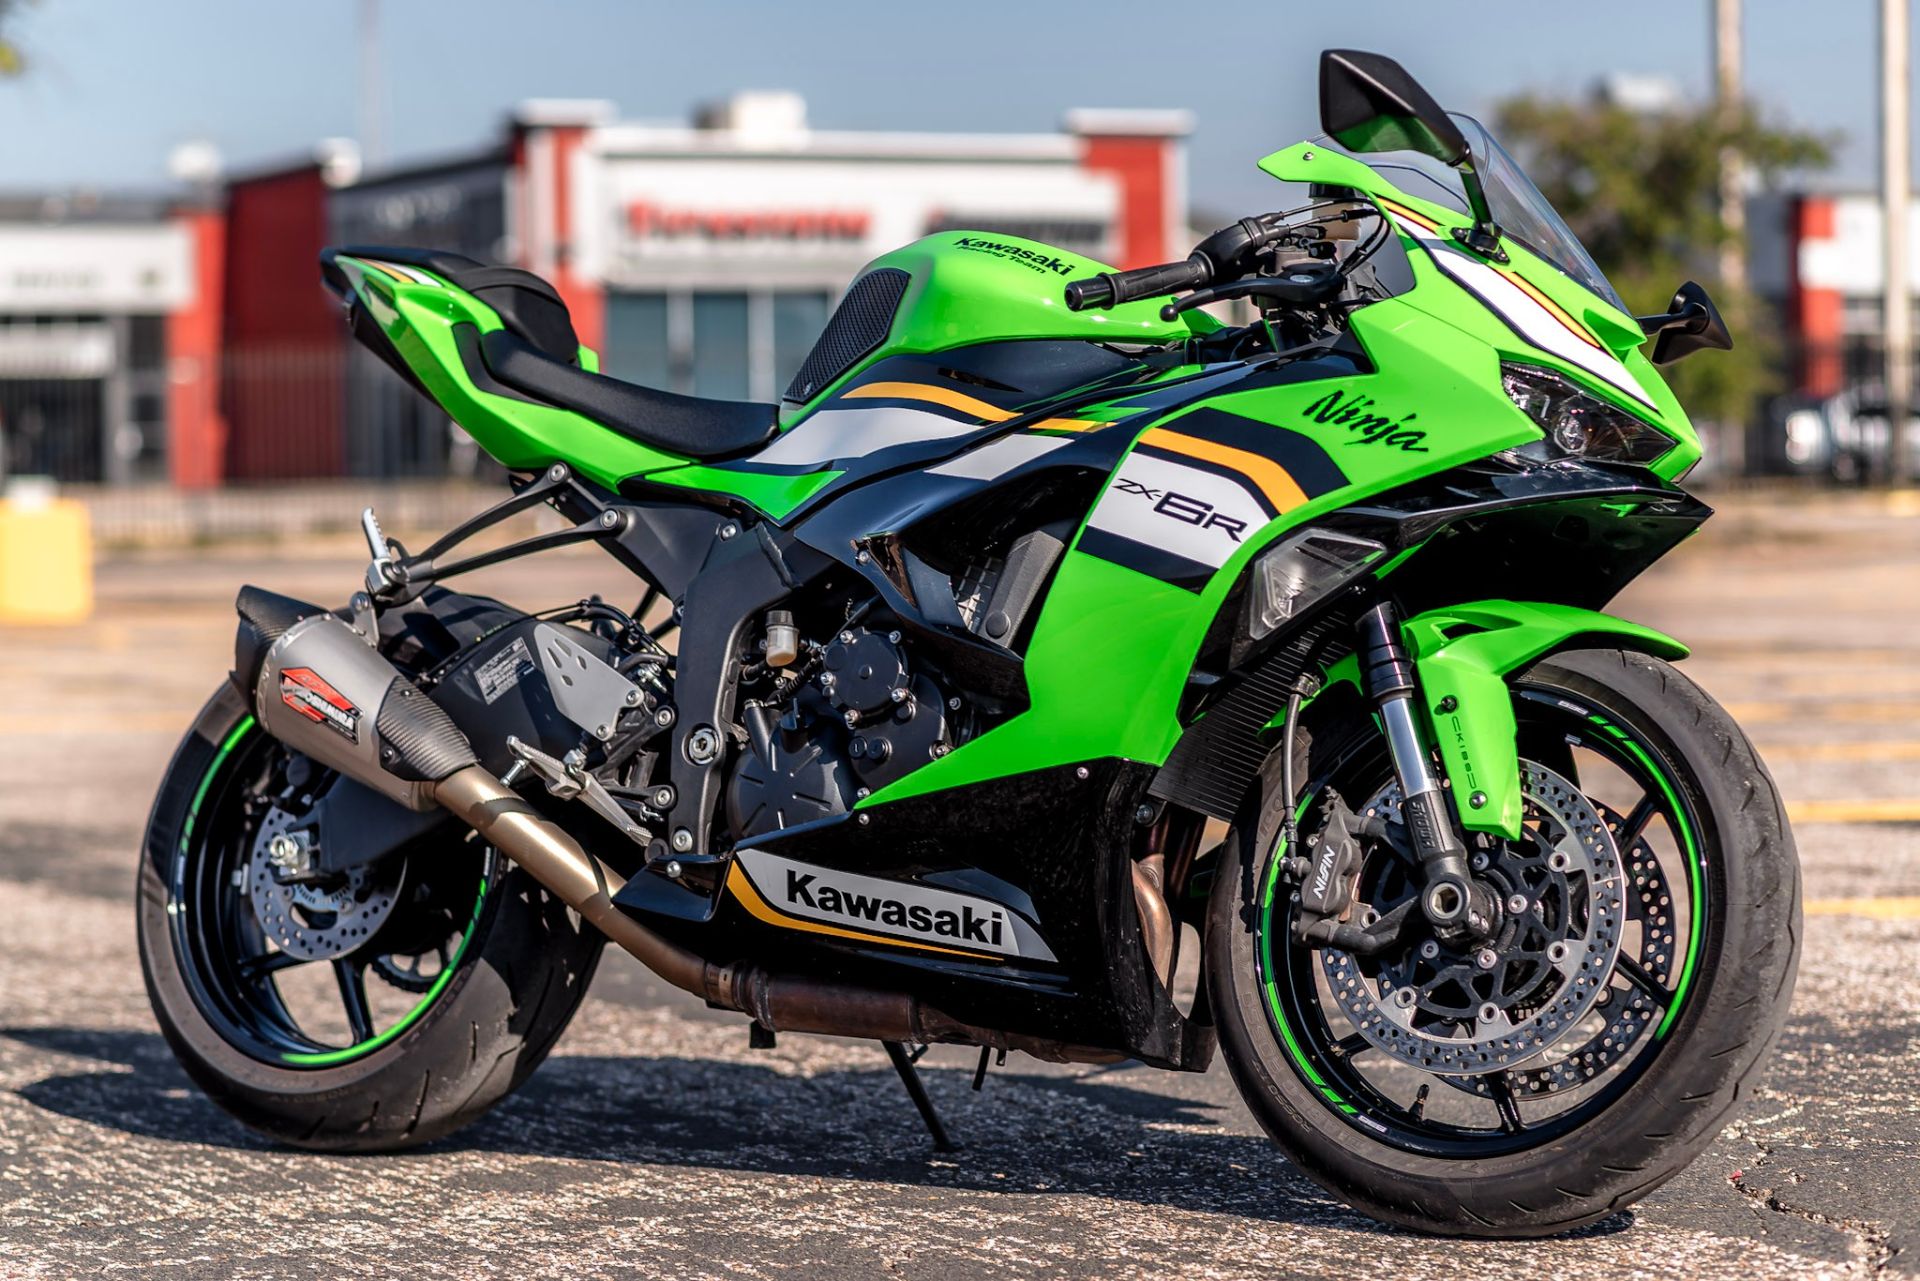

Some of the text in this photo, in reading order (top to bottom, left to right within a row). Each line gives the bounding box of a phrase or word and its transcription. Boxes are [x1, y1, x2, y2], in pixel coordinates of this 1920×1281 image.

[954, 237, 1076, 276] Kawasaki
[956, 246, 1046, 274] Racing Team
[1302, 390, 1429, 452] Ninja
[1112, 478, 1248, 543] ZX-6R
[786, 869, 1002, 946] Kawasaki
